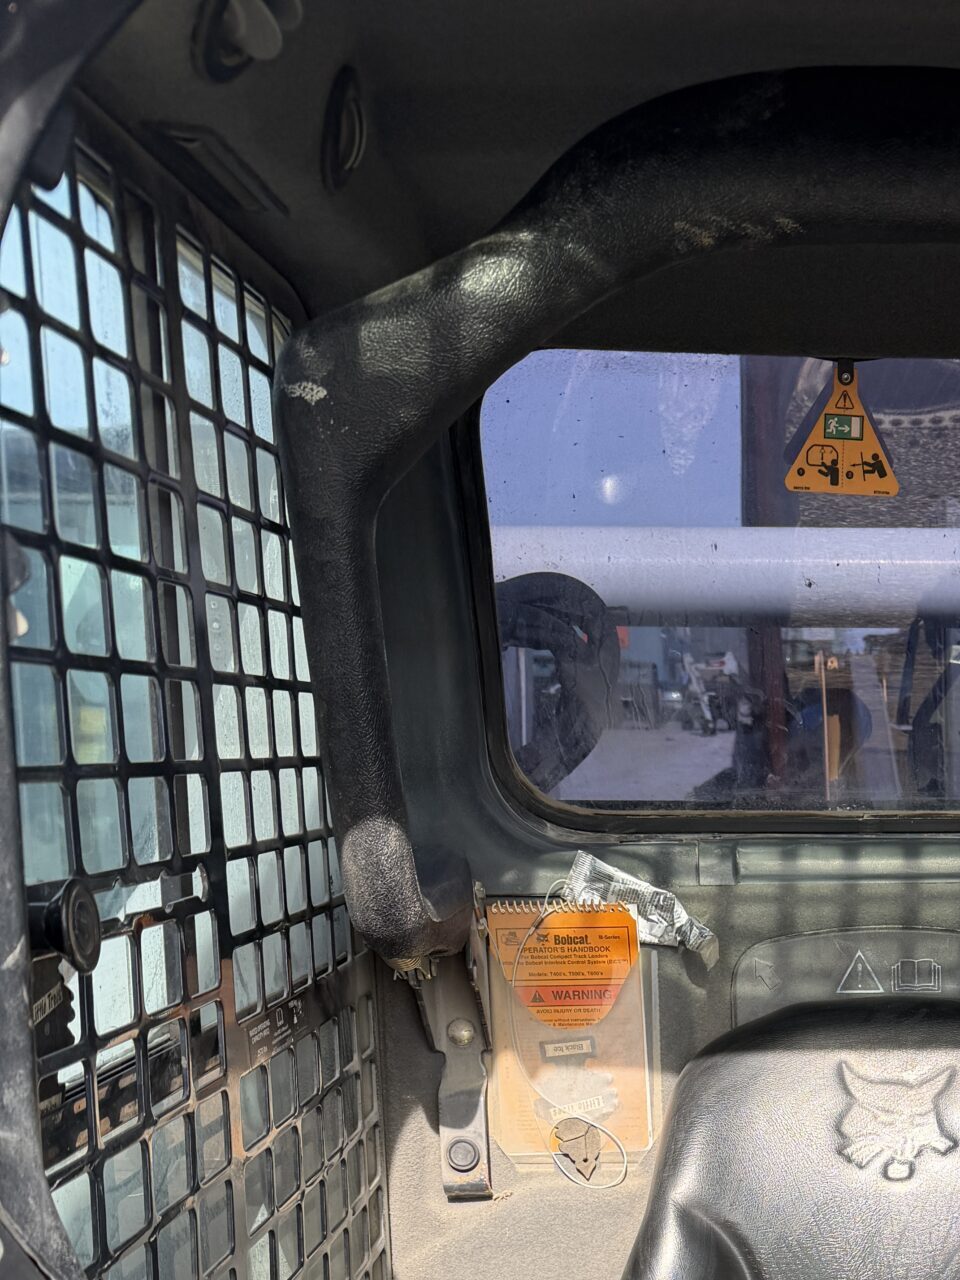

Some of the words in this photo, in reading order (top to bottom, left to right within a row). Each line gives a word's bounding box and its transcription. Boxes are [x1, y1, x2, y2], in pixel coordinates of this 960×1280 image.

[553, 934, 589, 946] Bobcat
[567, 945, 611, 953] HANDBOOK
[551, 989, 612, 1001] WARNING
[565, 1043, 584, 1052] Black
